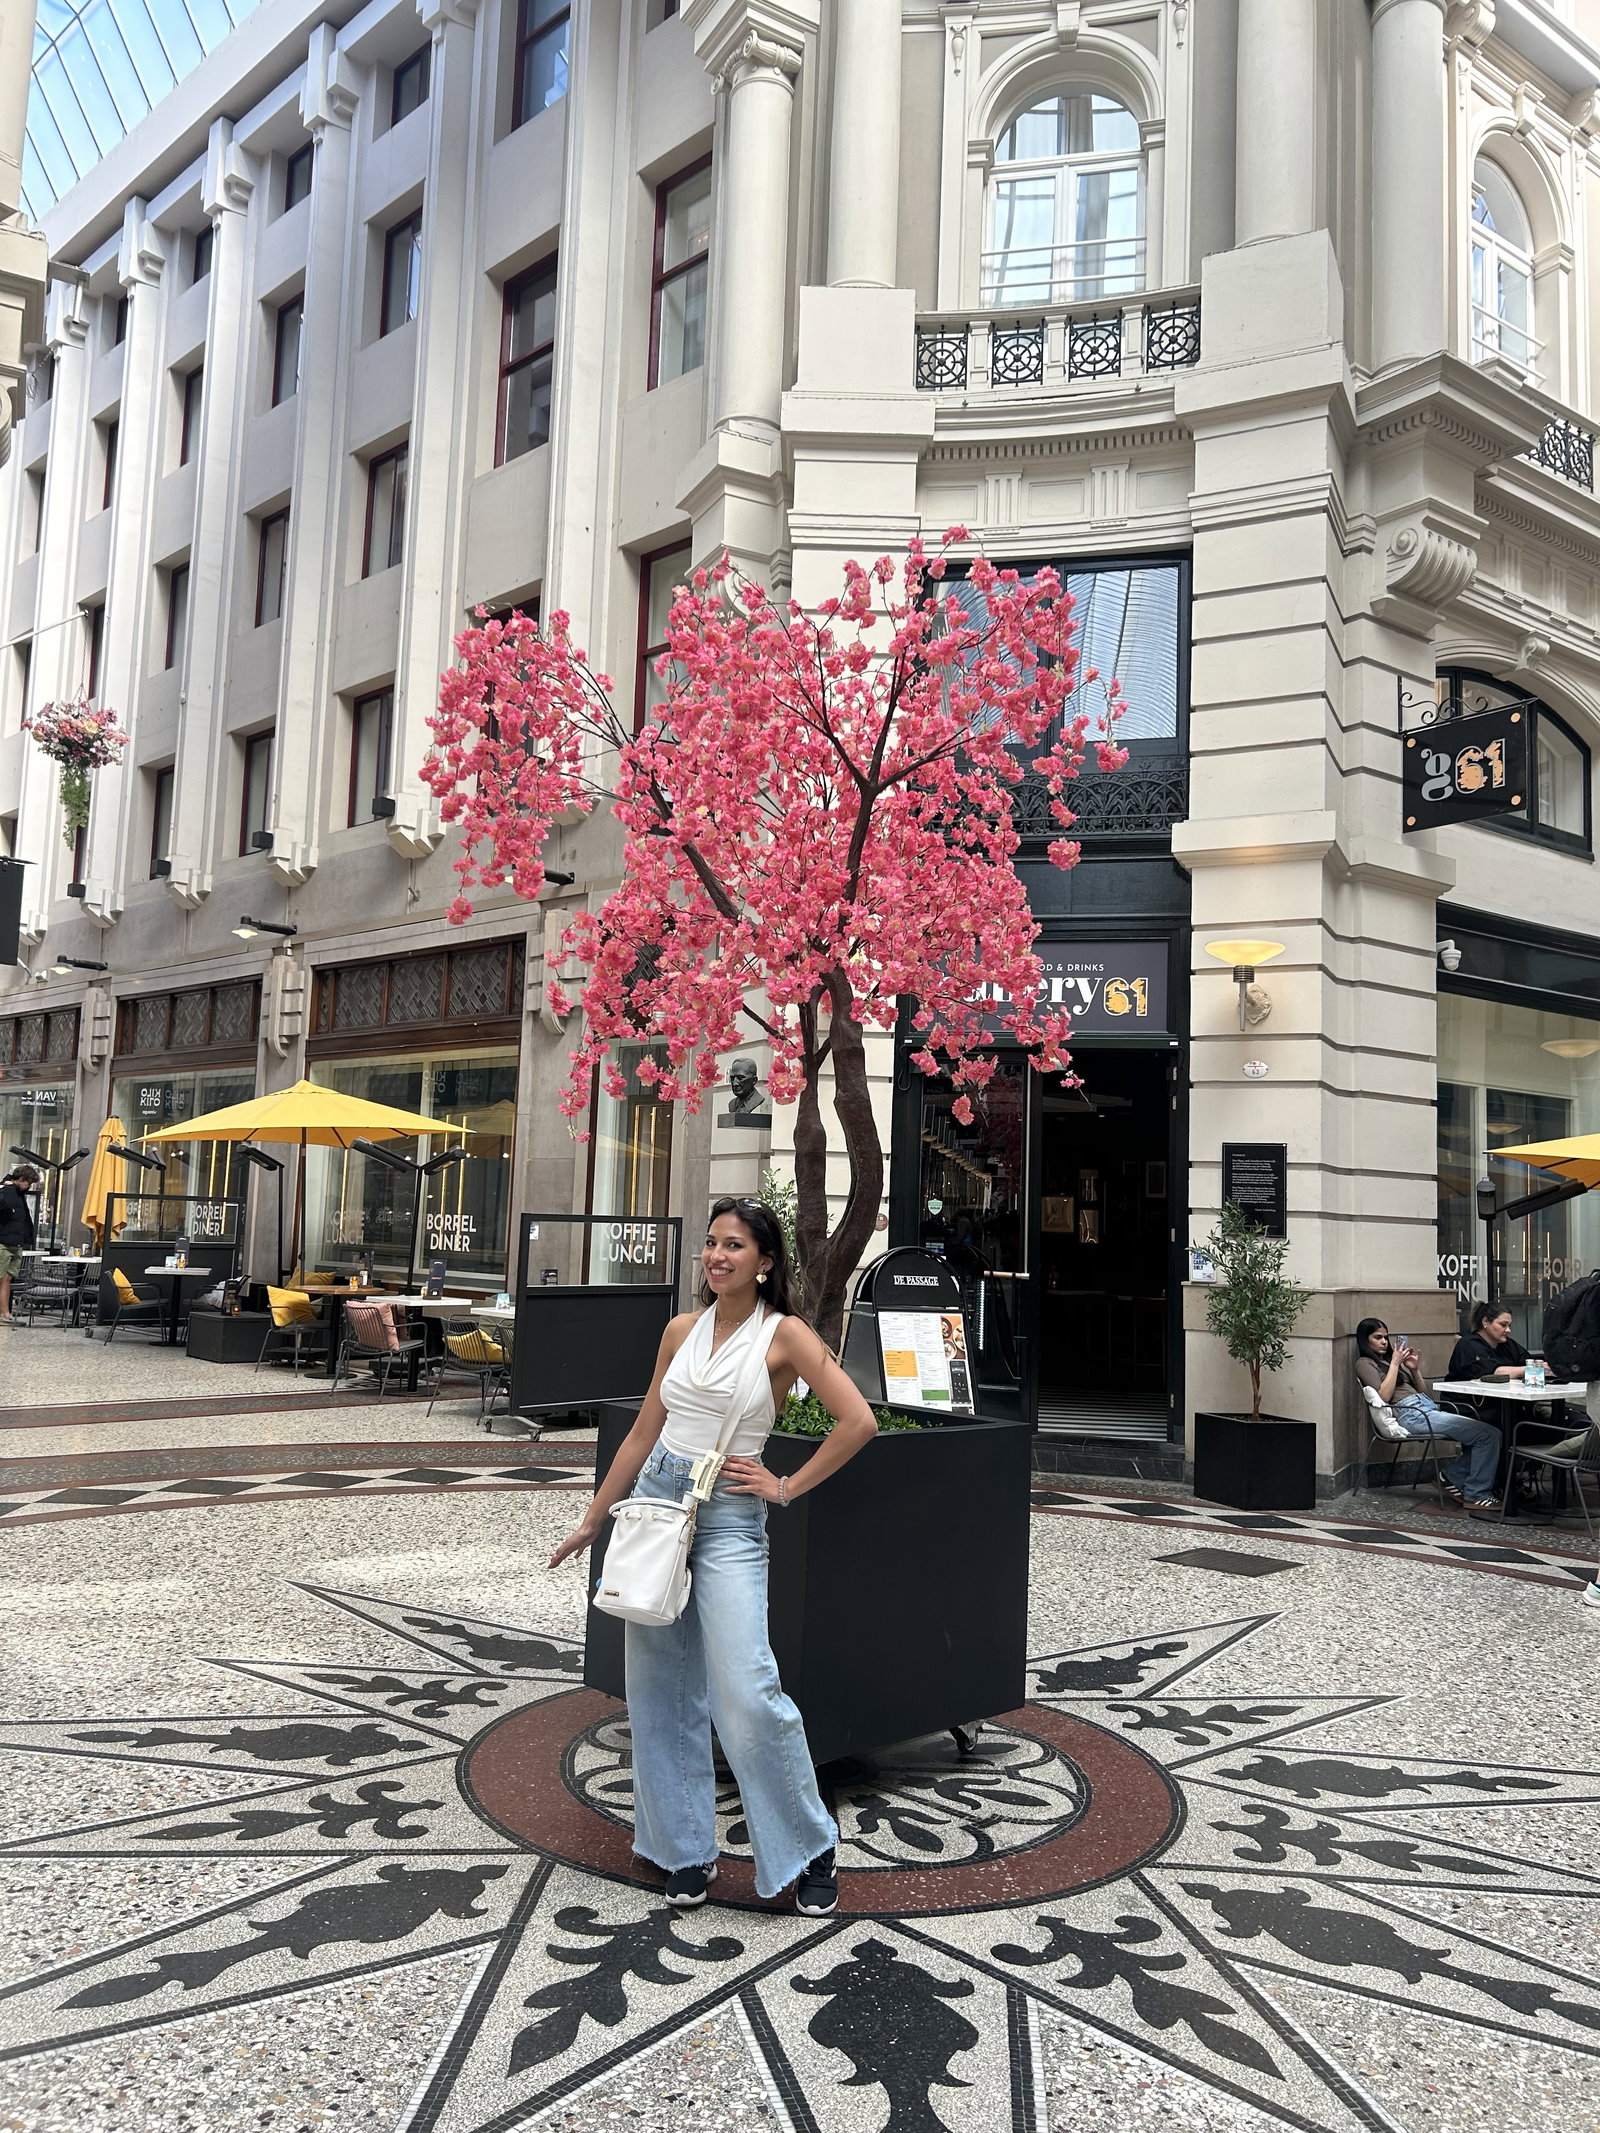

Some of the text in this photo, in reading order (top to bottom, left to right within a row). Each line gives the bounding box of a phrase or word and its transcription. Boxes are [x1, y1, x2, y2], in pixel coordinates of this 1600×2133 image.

[1056, 963, 1063, 972] &
[1067, 963, 1104, 972] DRINKS
[191, 1204, 224, 1220] BORREL
[193, 1220, 220, 1237] DINER
[426, 1213, 477, 1233] BORREL
[602, 1223, 657, 1242] KOFFIE
[430, 1233, 470, 1253] DINER
[600, 1243, 656, 1265] LUNCH
[893, 1275, 939, 1286] DE PASSAGE
